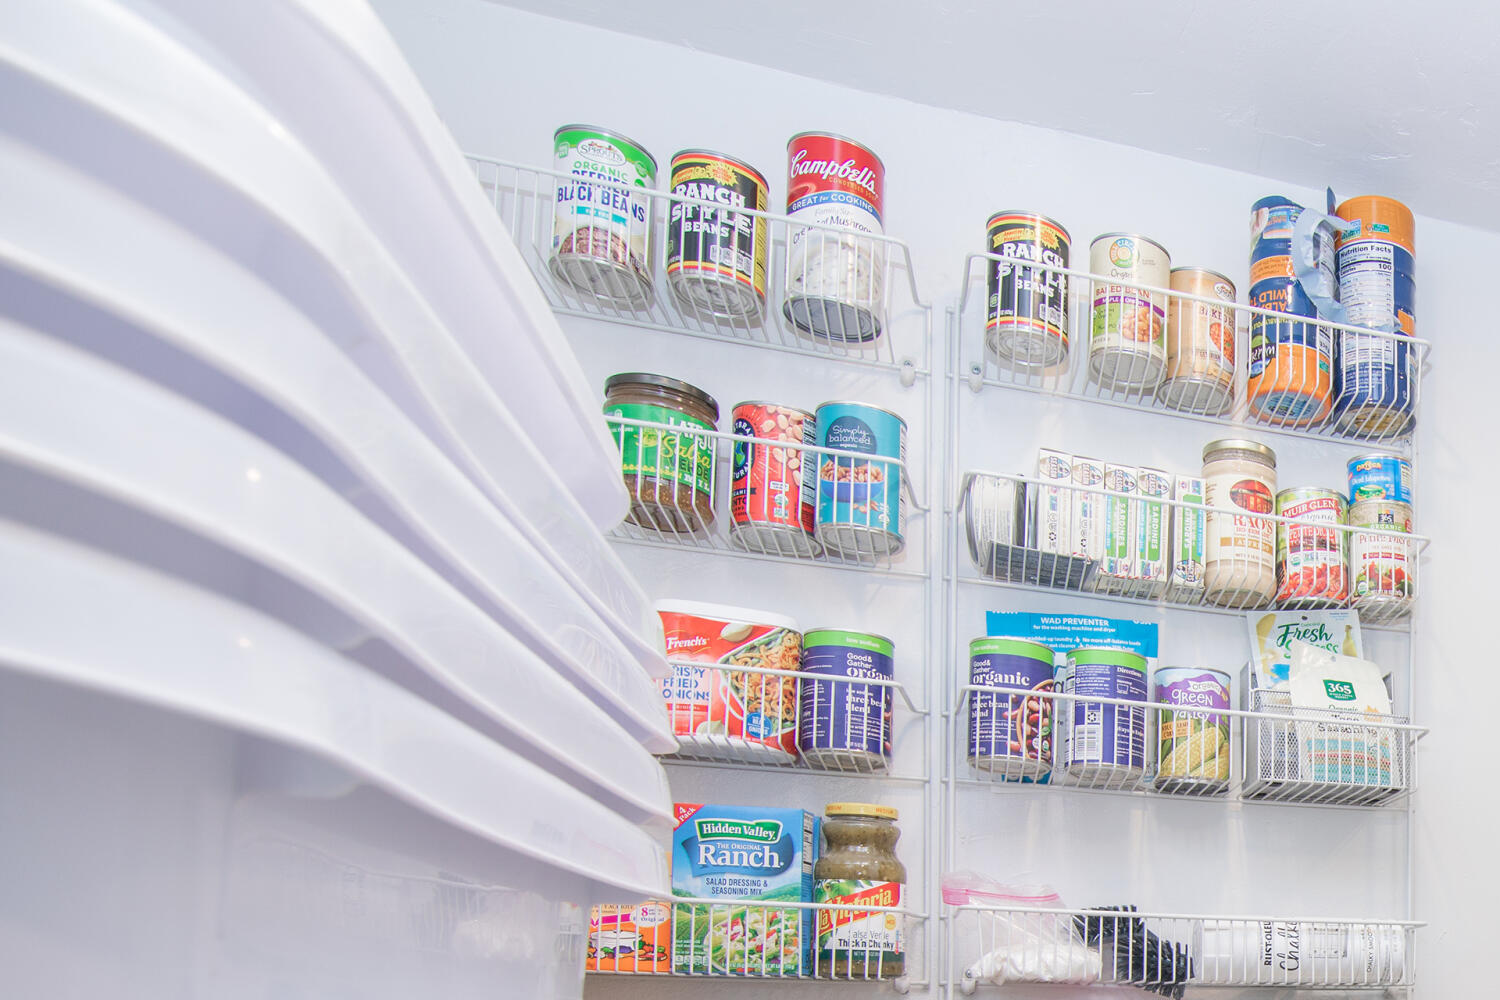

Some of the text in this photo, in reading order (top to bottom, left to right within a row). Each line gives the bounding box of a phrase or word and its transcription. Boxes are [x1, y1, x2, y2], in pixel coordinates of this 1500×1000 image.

[573, 160, 630, 181] ORGANIC
[791, 149, 877, 195] Campbell's
[675, 183, 745, 209] RANCH
[792, 196, 818, 211] GREAT
[831, 193, 873, 212] COOKING
[671, 203, 752, 233] STYLE
[684, 221, 730, 237] BEANS
[1002, 242, 1064, 269] RANCH
[1371, 245, 1391, 253] Facts
[1379, 263, 1391, 271] 100
[1017, 279, 1054, 298] BEANS
[1259, 289, 1287, 302] WILD
[829, 434, 871, 445] balanced
[833, 425, 869, 441] Simply
[1284, 499, 1335, 518] MUIR GLEN
[1041, 617, 1109, 626] WAD PREVENTER
[667, 636, 707, 649] French's
[1276, 623, 1333, 647] Fresh
[973, 670, 1030, 687] organic
[1328, 683, 1352, 694] 365
[679, 806, 686, 814] 4
[679, 807, 696, 821] Pack
[702, 823, 741, 835] Hidden
[698, 844, 781, 868] Ranch
[706, 878, 727, 887] SALAD
[729, 878, 762, 887] DRESSING
[711, 886, 762, 895] SEASONING MIX
[641, 907, 648, 917] 8
[826, 888, 892, 924] Victoria
